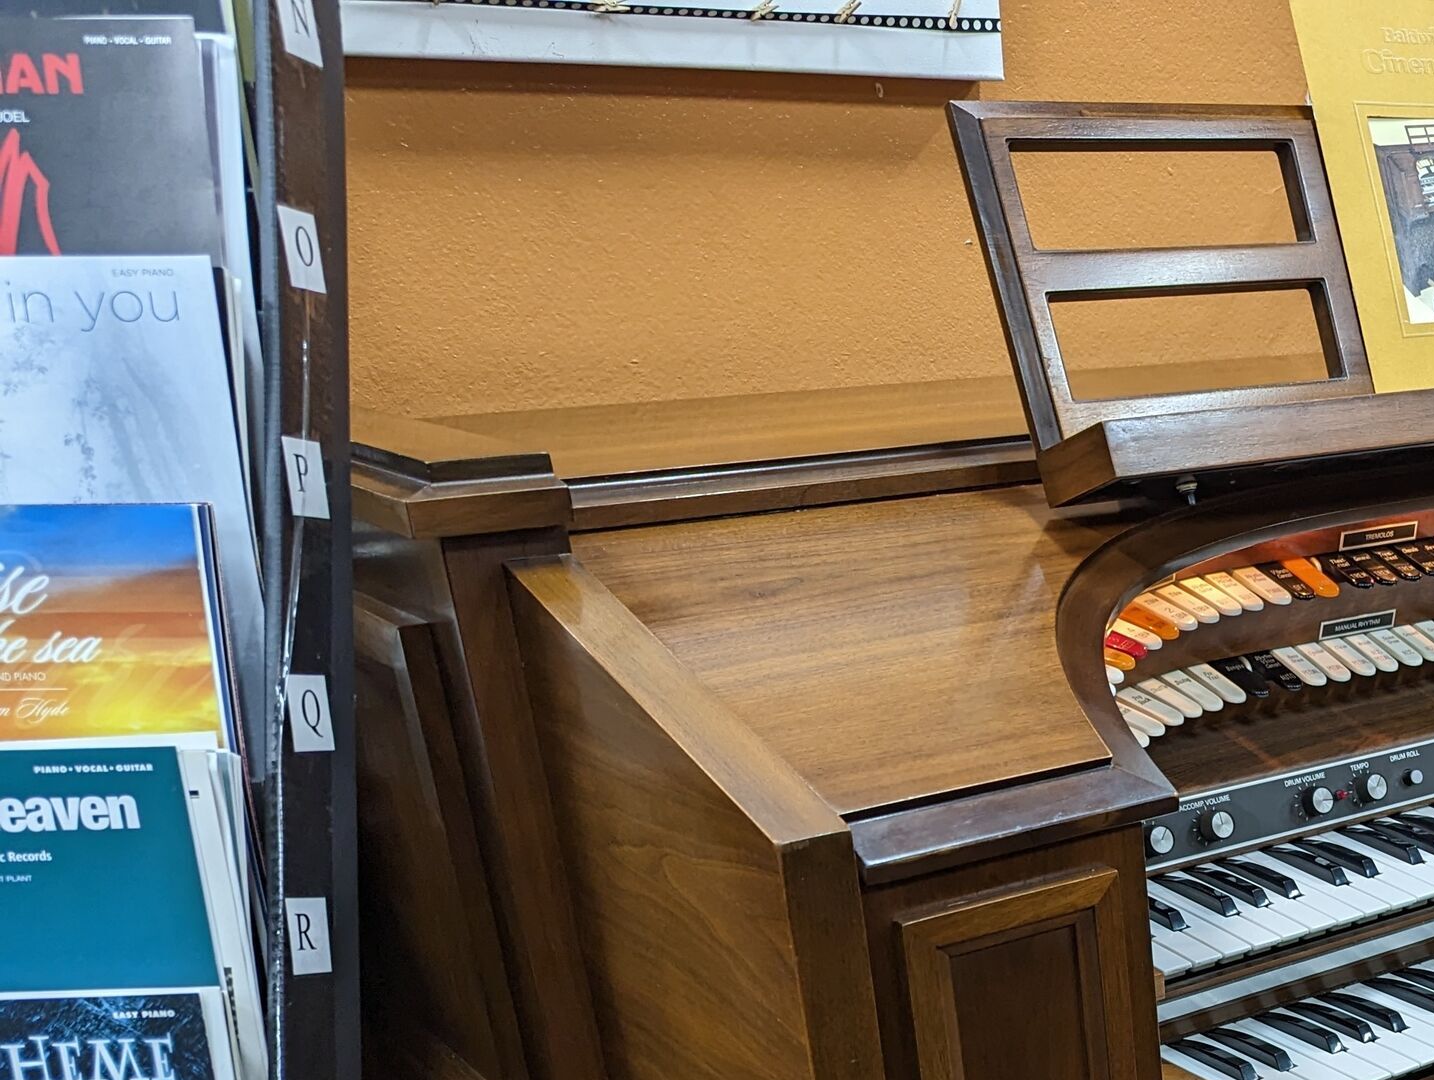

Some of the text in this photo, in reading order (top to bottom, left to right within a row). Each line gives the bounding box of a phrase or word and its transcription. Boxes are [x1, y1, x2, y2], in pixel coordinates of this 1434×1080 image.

[294, 0, 310, 36] N
[0, 52, 85, 95] AN
[295, 226, 314, 268] O
[112, 268, 174, 277] EASY PIANO
[74, 288, 181, 333] you
[293, 454, 309, 492] P
[1365, 530, 1395, 541] TREMOLOS
[32, 630, 104, 664] sea
[14, 671, 46, 682] PIANO
[301, 689, 323, 738] Q
[33, 763, 153, 774] PIANO VOCAL GUITAR
[1350, 761, 1370, 772] TEMPO
[1284, 771, 1326, 788] DRUM VOLUME
[1203, 794, 1231, 807] VOLUME
[0, 794, 141, 833] eaven
[7, 850, 52, 862] Records
[296, 913, 317, 951] R
[113, 1009, 175, 1019] EASY PIANO
